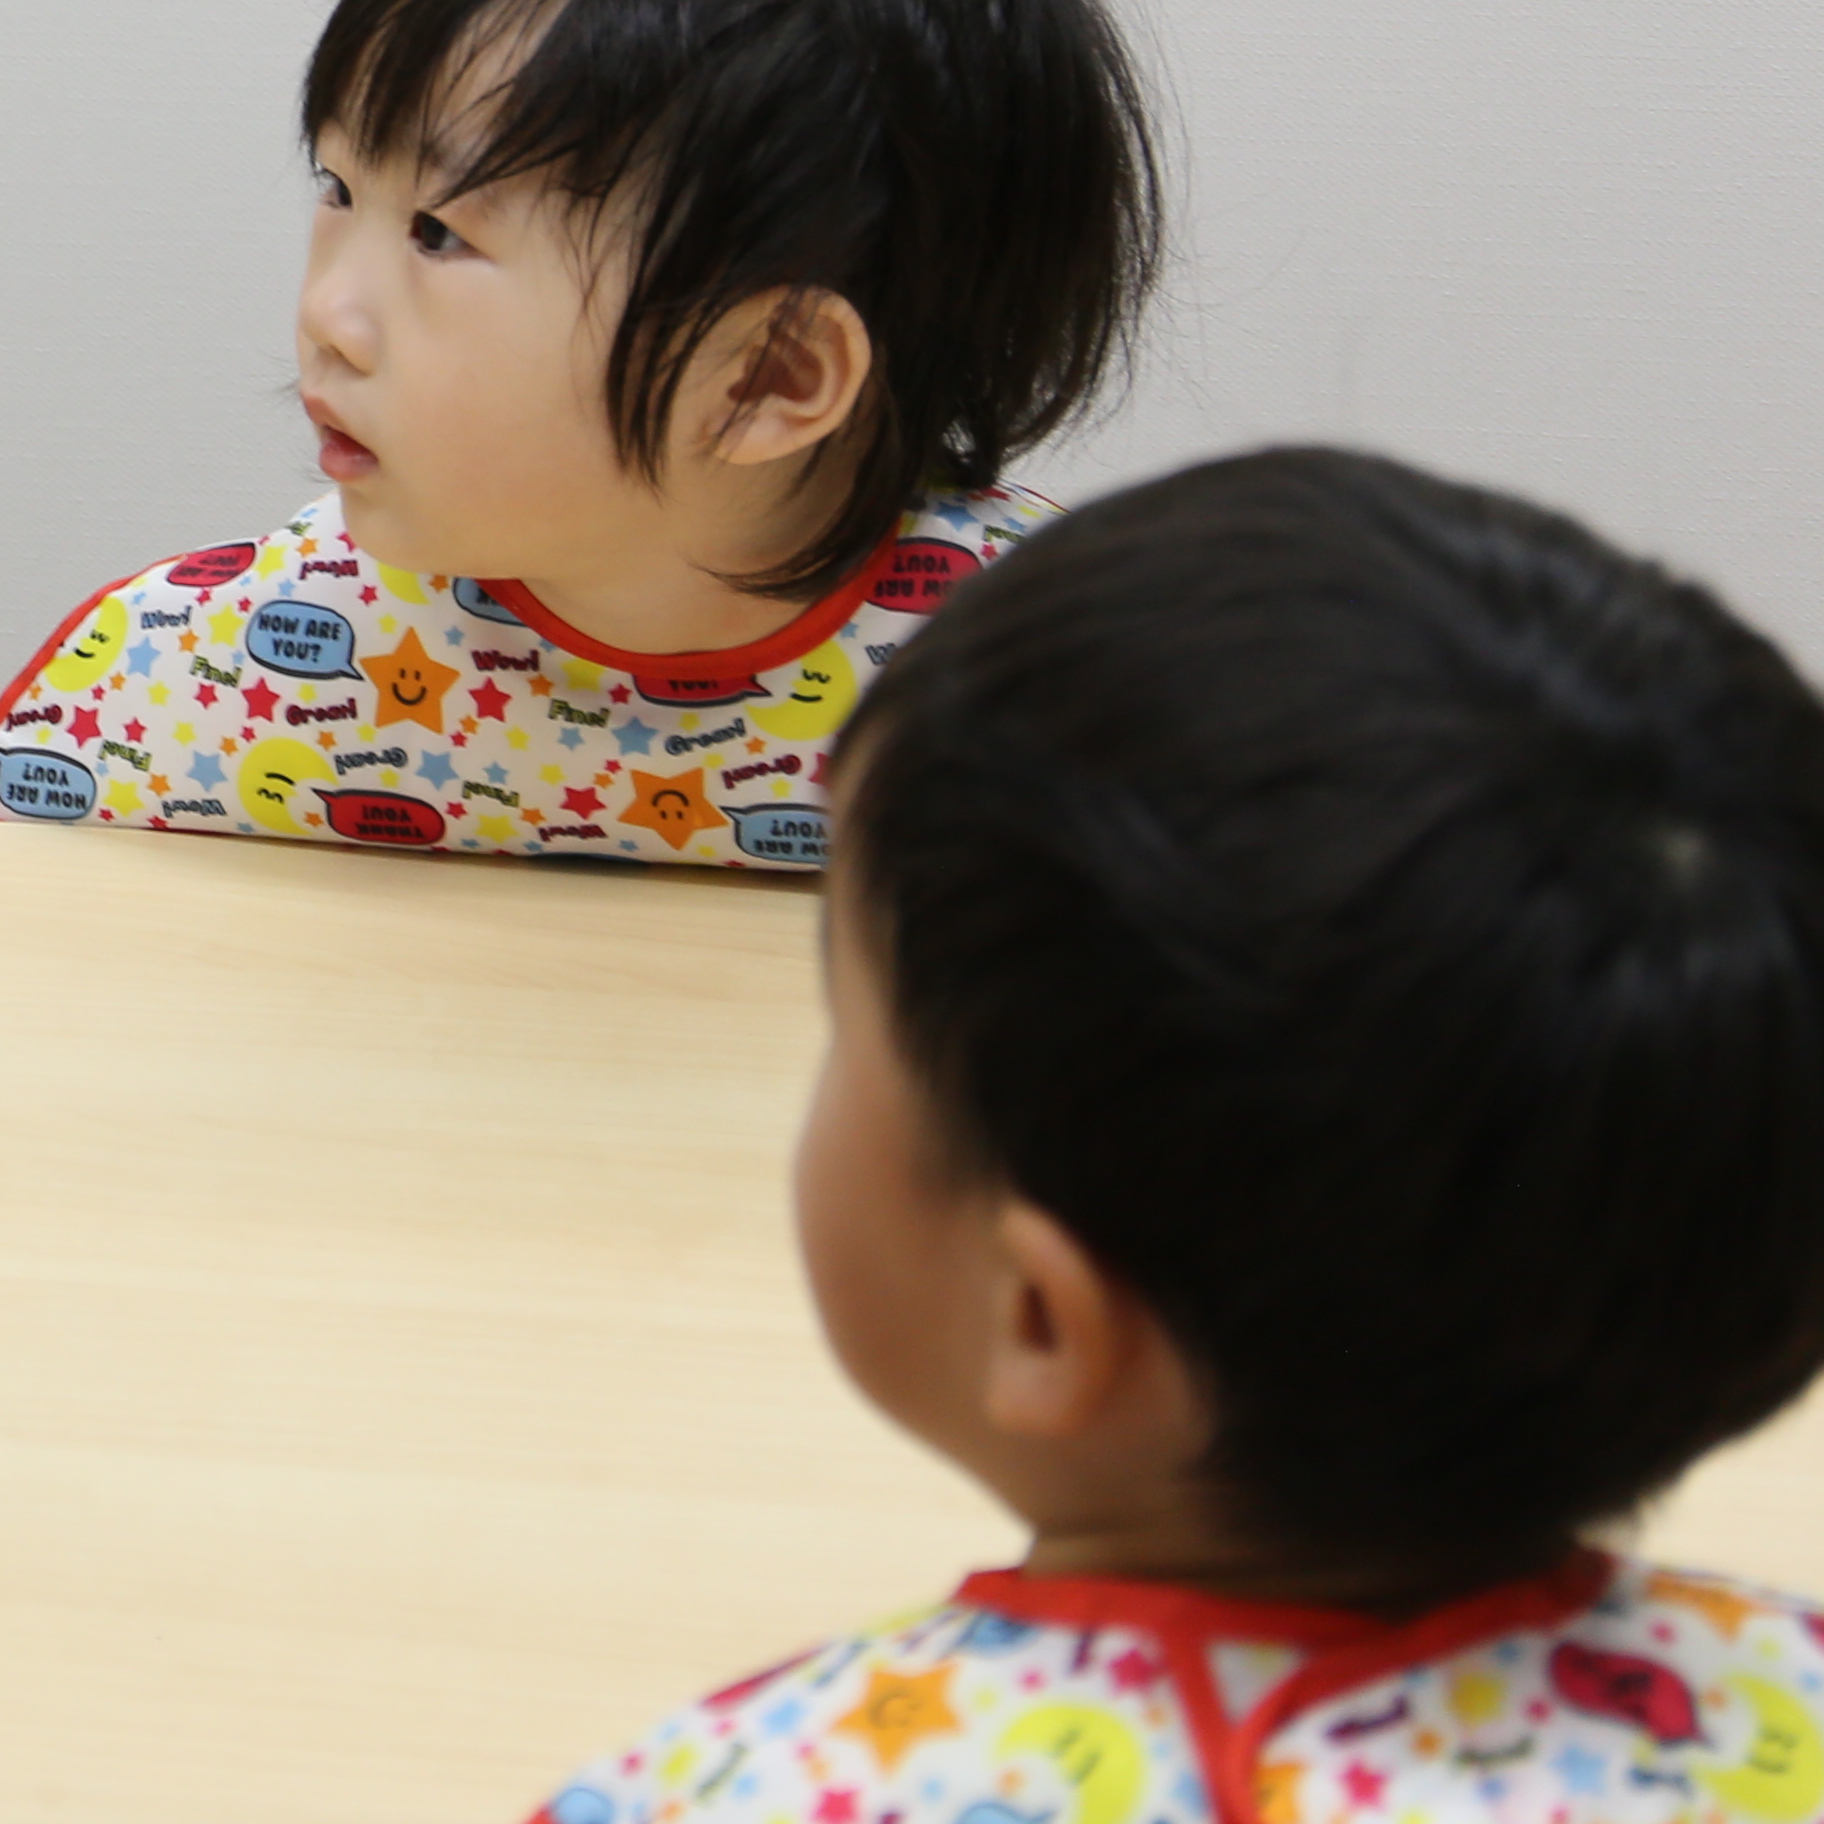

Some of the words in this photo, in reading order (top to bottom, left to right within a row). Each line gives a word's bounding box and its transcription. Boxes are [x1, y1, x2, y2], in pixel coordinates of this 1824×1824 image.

[891, 555, 951, 574] YOU?
[140, 604, 193, 631] Wow!
[258, 613, 300, 634] HOW
[305, 619, 343, 642] ARE
[271, 637, 323, 663] YOU?
[471, 648, 542, 674] Wow!
[189, 655, 243, 689] Fine!
[548, 697, 612, 729] Fine!
[98, 739, 153, 773] Fine!
[21, 761, 71, 787] YOU?
[7, 783, 38, 805] ARE
[43, 787, 88, 811] HOW
[161, 797, 228, 819] Wow!
[361, 804, 412, 823] YOU!
[355, 822, 426, 839] THANK
